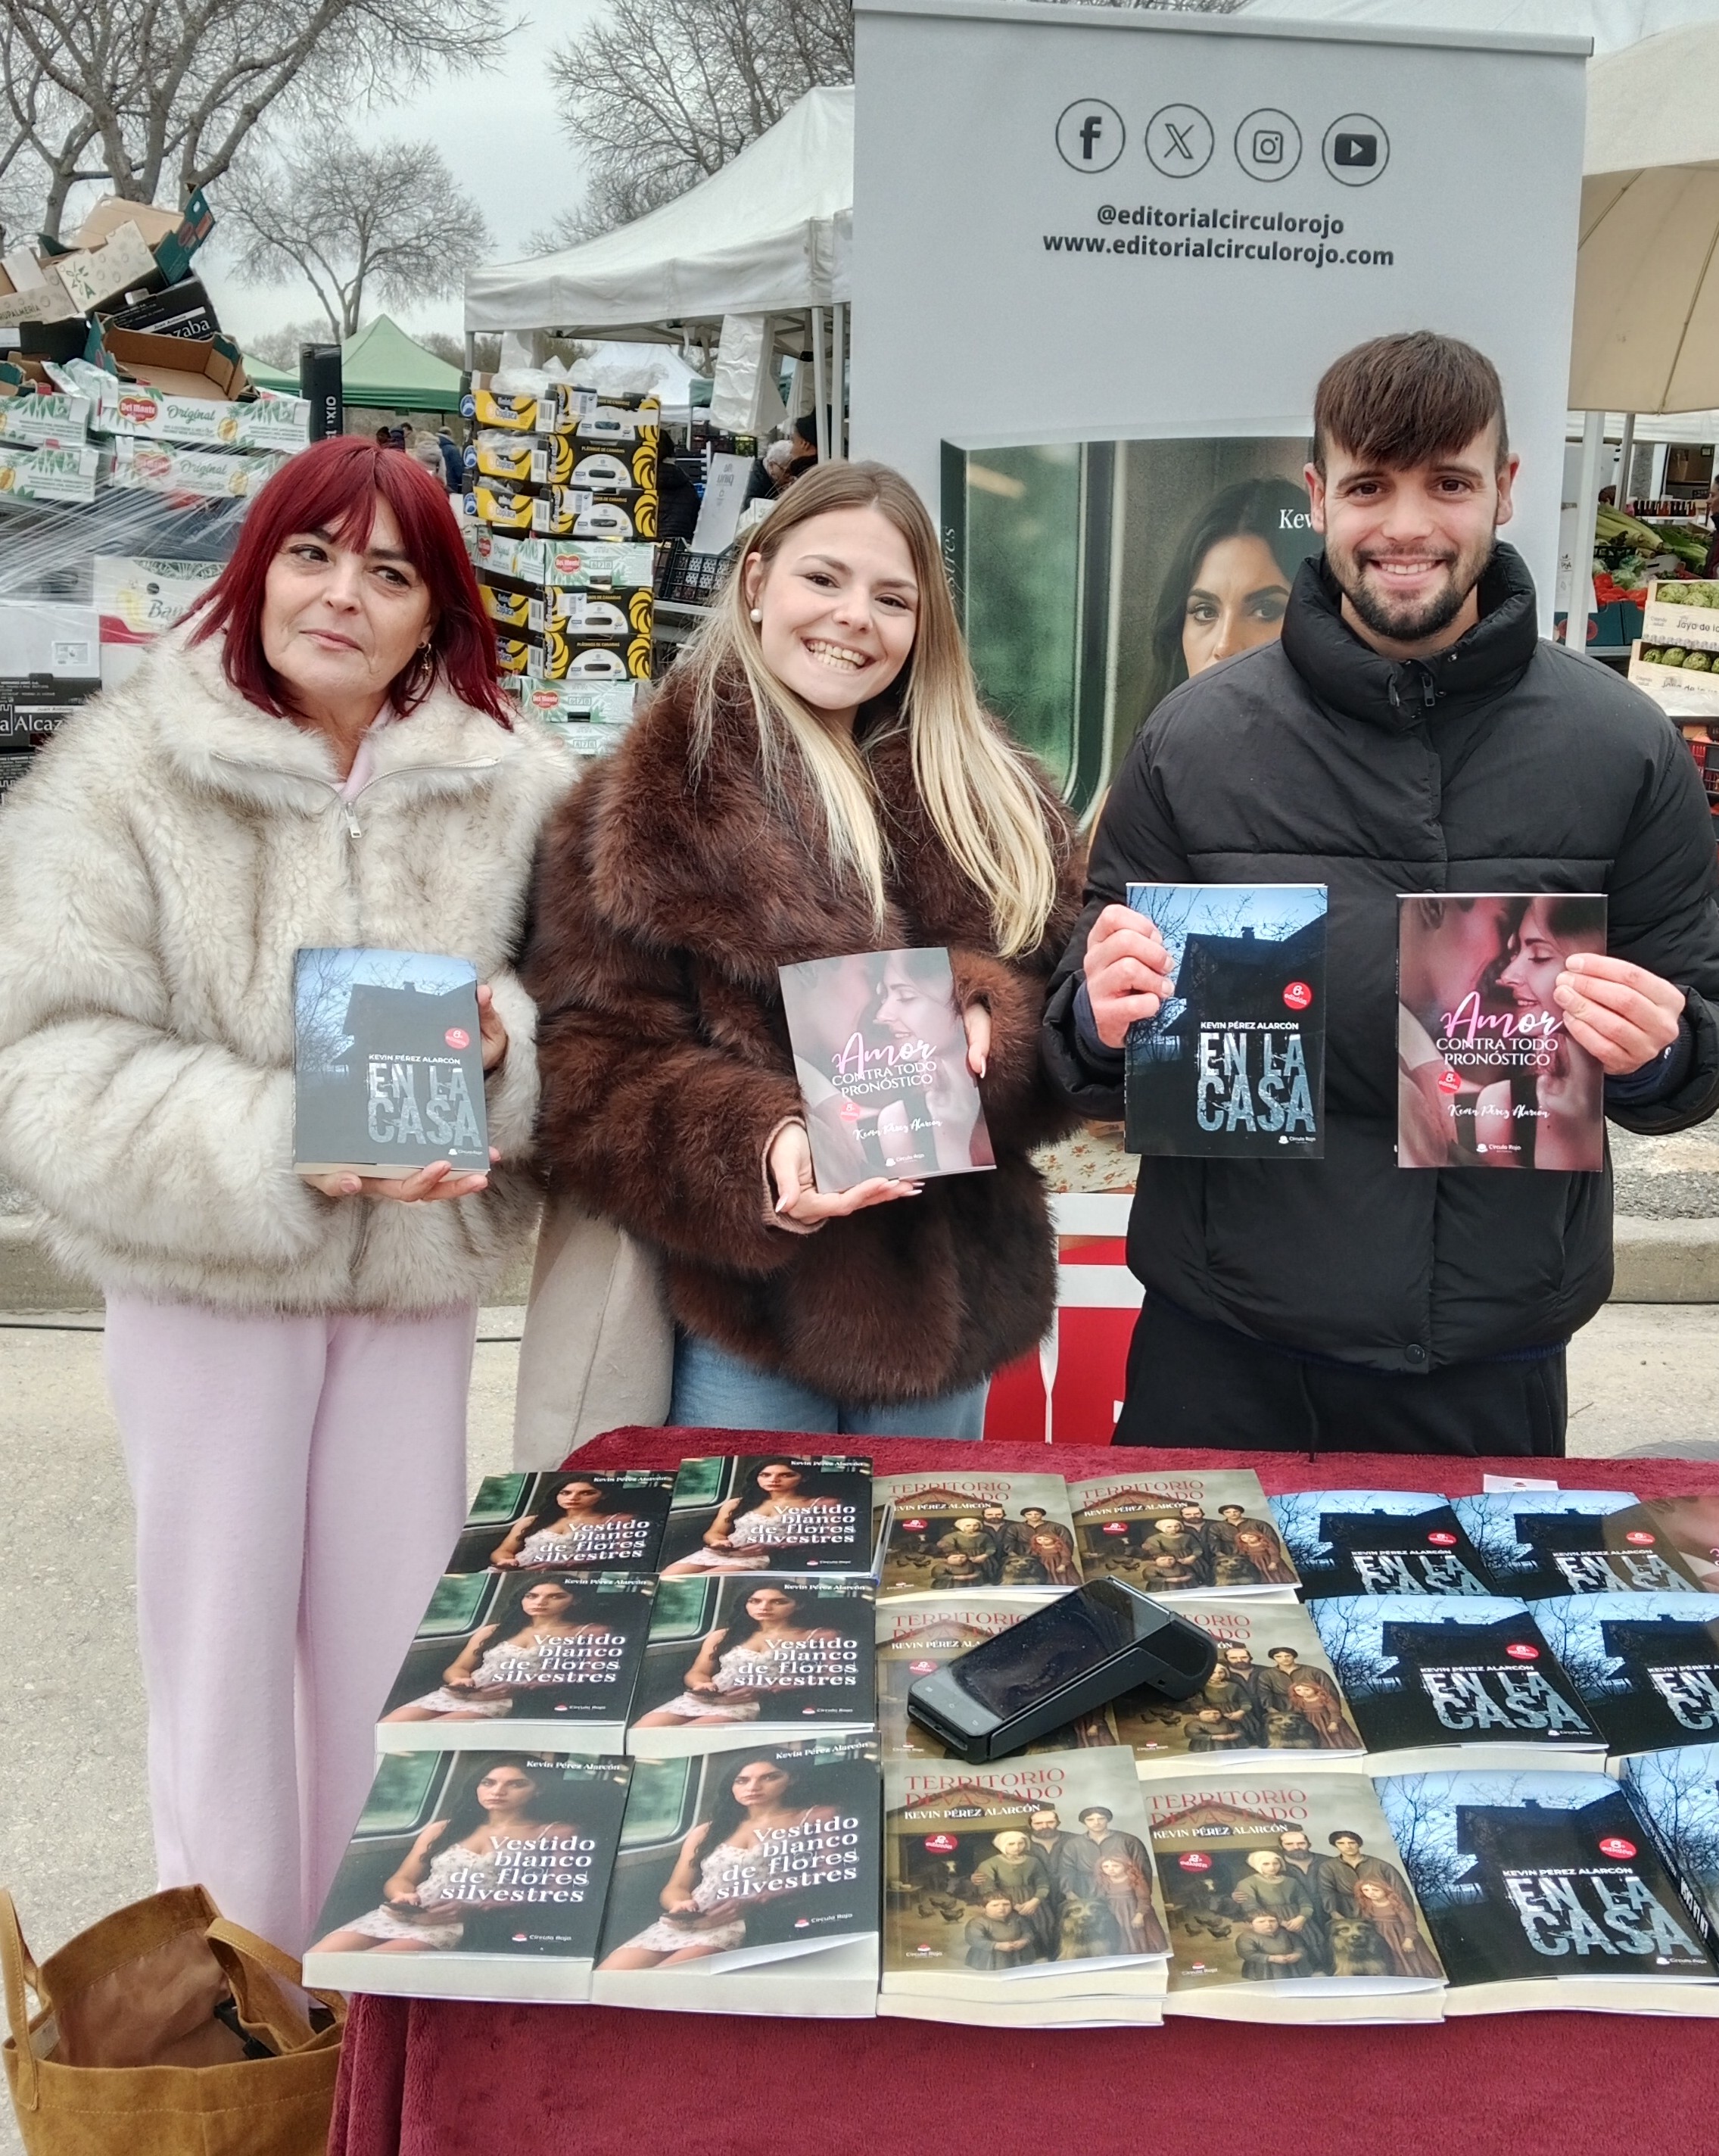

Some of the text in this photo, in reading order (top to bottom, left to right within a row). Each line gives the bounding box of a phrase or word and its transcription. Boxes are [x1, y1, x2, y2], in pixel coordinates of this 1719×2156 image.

[1096, 204, 1344, 238] @editorialcirculorojo
[1042, 232, 1394, 267] www.editorialcirculorojo.com
[166, 319, 210, 338] zaba
[167, 405, 216, 424] Original
[496, 604, 515, 615] Coplaca
[14, 714, 63, 731] Alcaz
[1228, 1020, 1256, 1030] PÉREZ
[1257, 1020, 1300, 1030] ALARCÓN
[1440, 991, 1562, 1048] Amor
[1436, 1037, 1559, 1052] CONTRA TODO
[369, 1053, 461, 1065] KEVIN PÉREZ ALARCÓN
[831, 1032, 937, 1080] Amor
[1197, 1032, 1307, 1076] EN LA
[1443, 1050, 1550, 1067] PRONÓSTICO
[366, 1062, 470, 1101] EN LA
[832, 1061, 937, 1087] CONTRA TODO
[841, 1073, 933, 1097] PRONÓSTICO
[1197, 1073, 1316, 1133] CASA
[1447, 1104, 1478, 1117] Kevin
[367, 1097, 483, 1148] CASA
[888, 1481, 1011, 1494] TERRITORIO
[1080, 1479, 1204, 1499] TERRITORIO
[774, 1504, 856, 1515] Vestido
[894, 1503, 915, 1512] EVIN
[568, 1519, 650, 1532] Vestido
[782, 1514, 855, 1524] blanco
[573, 1529, 648, 1541] blanco
[751, 1524, 855, 1534] de flores
[540, 1539, 645, 1553] de flores
[746, 1534, 855, 1544] silvestres
[533, 1549, 643, 1562] silvestres
[1352, 1554, 1467, 1576] EN LA
[1556, 1554, 1672, 1578] EN LA
[1361, 1573, 1491, 1596] CASA
[1568, 1572, 1701, 1595] CASA
[534, 1633, 626, 1646] Vestido
[765, 1637, 858, 1650] Vestido
[892, 1641, 923, 1650] KEVIN
[926, 1640, 959, 1649] PÉREZ
[538, 1646, 623, 1657] blanco
[774, 1650, 858, 1661] blanco
[500, 1658, 620, 1671] de flores
[738, 1662, 858, 1674] de flores
[492, 1671, 617, 1683] silvestres
[733, 1674, 857, 1686] silvestres
[1421, 1671, 1553, 1699] EN LA
[1649, 1671, 1719, 1698] EN
[1432, 1693, 1590, 1730] CASA
[526, 1760, 554, 1768] Kevin
[775, 1751, 803, 1760] Kevin
[905, 1768, 1065, 1790] TERRITORIO
[905, 1785, 1063, 1807] DEVASTADO
[1146, 1788, 1306, 1810] TERRITORIO
[1150, 1805, 1308, 1827] DEVASTADO
[753, 1815, 858, 1842] Vestido
[490, 1836, 596, 1851] Vestido
[763, 1832, 858, 1858] blanco
[494, 1851, 592, 1868] blanco
[722, 1849, 858, 1883] de flores
[450, 1868, 589, 1886] de flores
[1539, 1868, 1577, 1877] PÉREZ
[1579, 1866, 1633, 1875] ALARCÓN
[716, 1866, 858, 1901] silvestres
[440, 1885, 584, 1903] silvestres
[1504, 1876, 1664, 1912] EN LA
[1520, 1908, 1703, 1956] CASA
